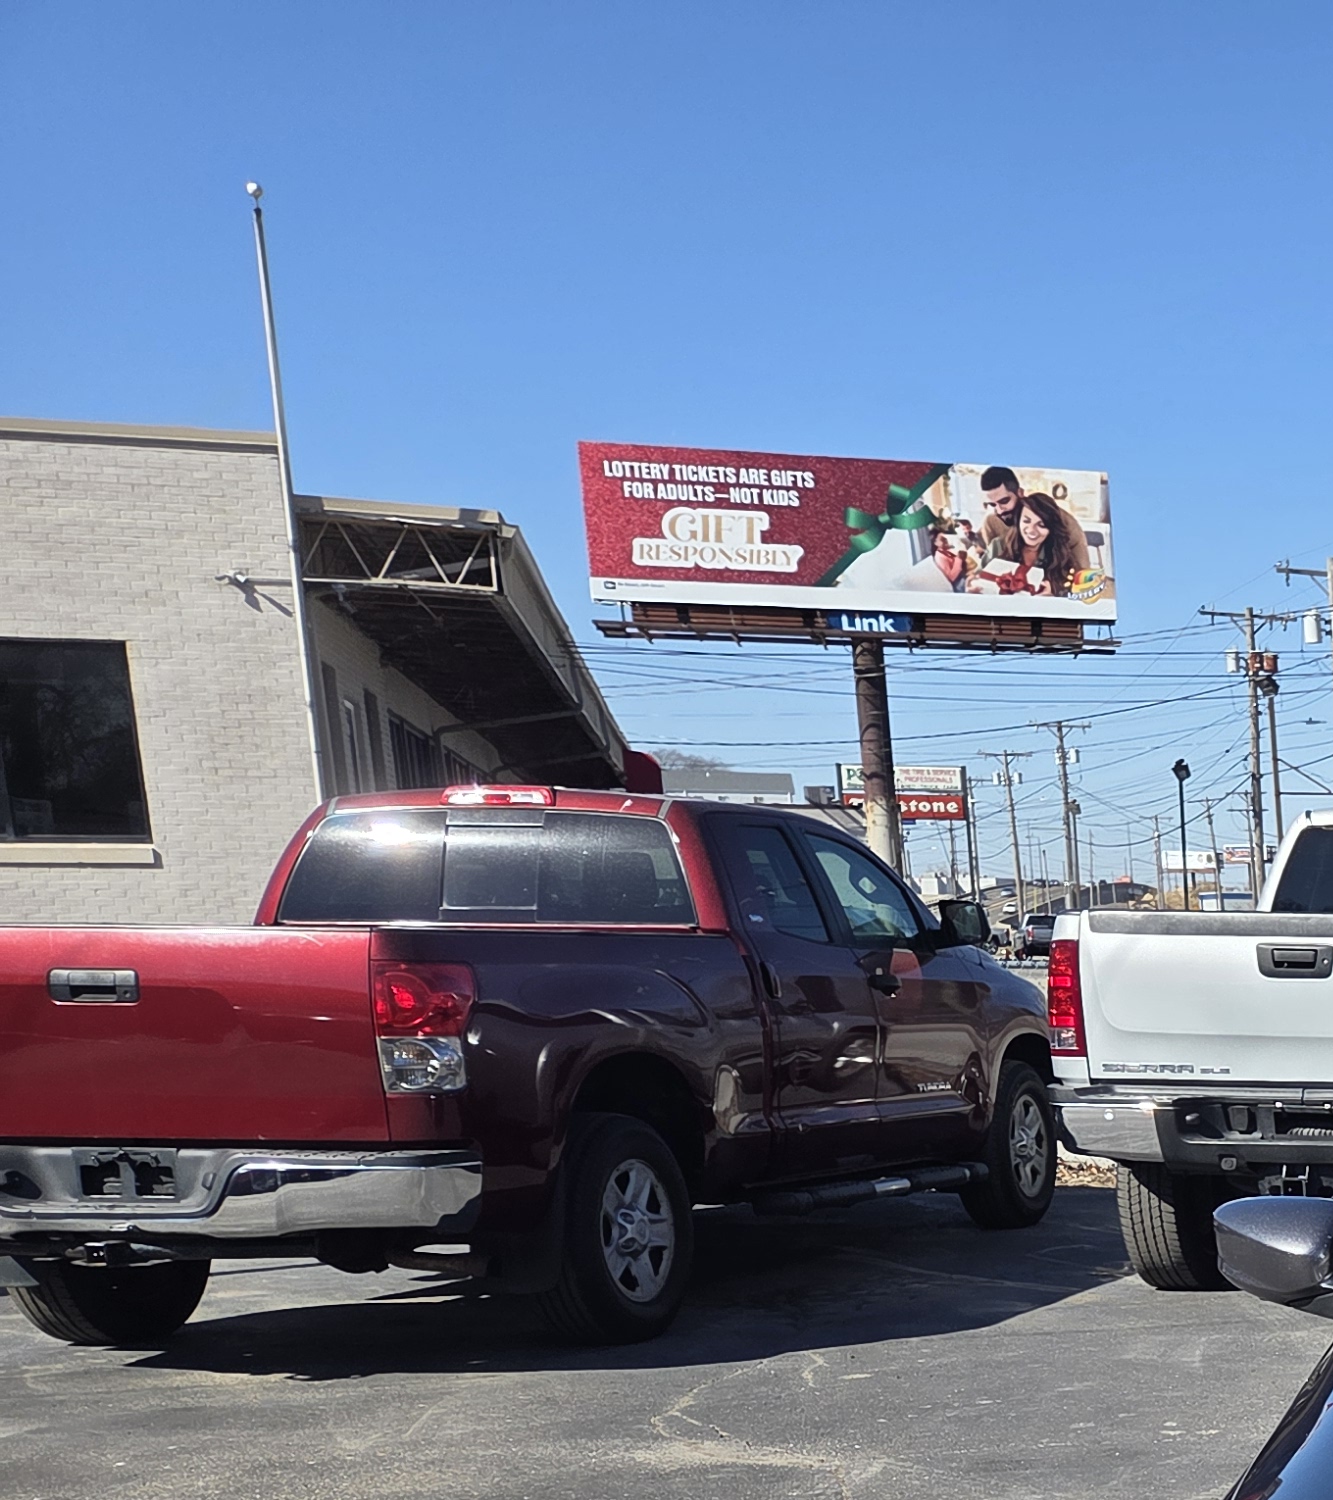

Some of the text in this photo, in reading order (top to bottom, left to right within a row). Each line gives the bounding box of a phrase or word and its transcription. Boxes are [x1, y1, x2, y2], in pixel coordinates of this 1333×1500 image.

[603, 460, 815, 488] LOTTERY TICKETS ARE GIFTS
[623, 481, 655, 499] FOR
[763, 490, 800, 507] KIDS
[668, 512, 763, 545] GIFT
[639, 543, 794, 567] RESPONSIBLY
[841, 613, 898, 633] Link
[1102, 1063, 1195, 1074] SIERRA
